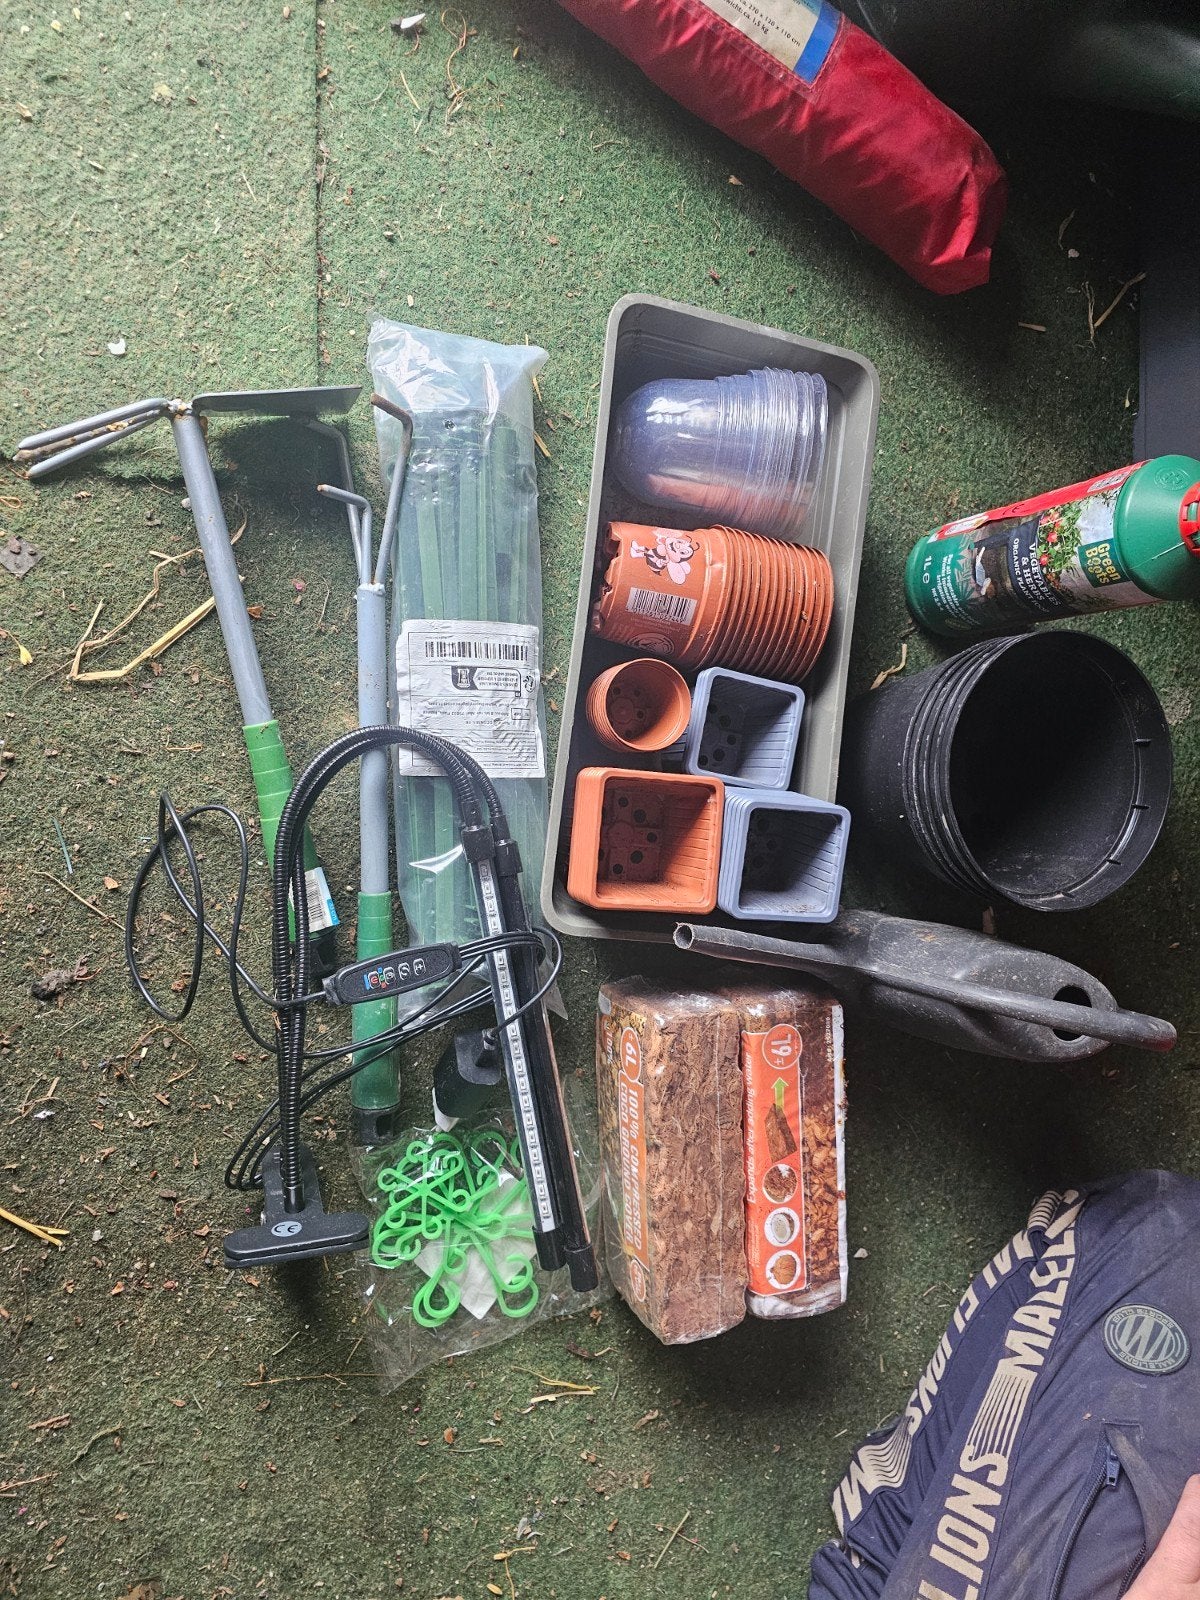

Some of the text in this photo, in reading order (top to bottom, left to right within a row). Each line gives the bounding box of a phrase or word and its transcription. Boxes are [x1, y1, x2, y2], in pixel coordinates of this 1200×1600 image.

[761, 24, 770, 34] kg
[924, 556, 932, 570] 1L
[1012, 538, 1020, 576] ORGANIC
[1018, 577, 1034, 599] PLANT
[1021, 556, 1045, 601] & HERBS
[1029, 543, 1062, 606] VEGETABLES
[1098, 543, 1120, 581] Green
[626, 1042, 637, 1068] 6L
[770, 1034, 792, 1056] 6L
[629, 1088, 640, 1140] 100%
[746, 1088, 756, 1129] adding
[620, 1082, 634, 1244] COCO GROUND COVER
[746, 1128, 755, 1158] after
[630, 1145, 642, 1250] COMPRESSED
[746, 1160, 756, 1204] Expands
[999, 1222, 1075, 1374] MALEL
[1112, 1308, 1174, 1328] SPORTS CLUB
[1119, 1351, 1176, 1369] MALELIONS
[917, 1444, 1018, 1600] LIONS
